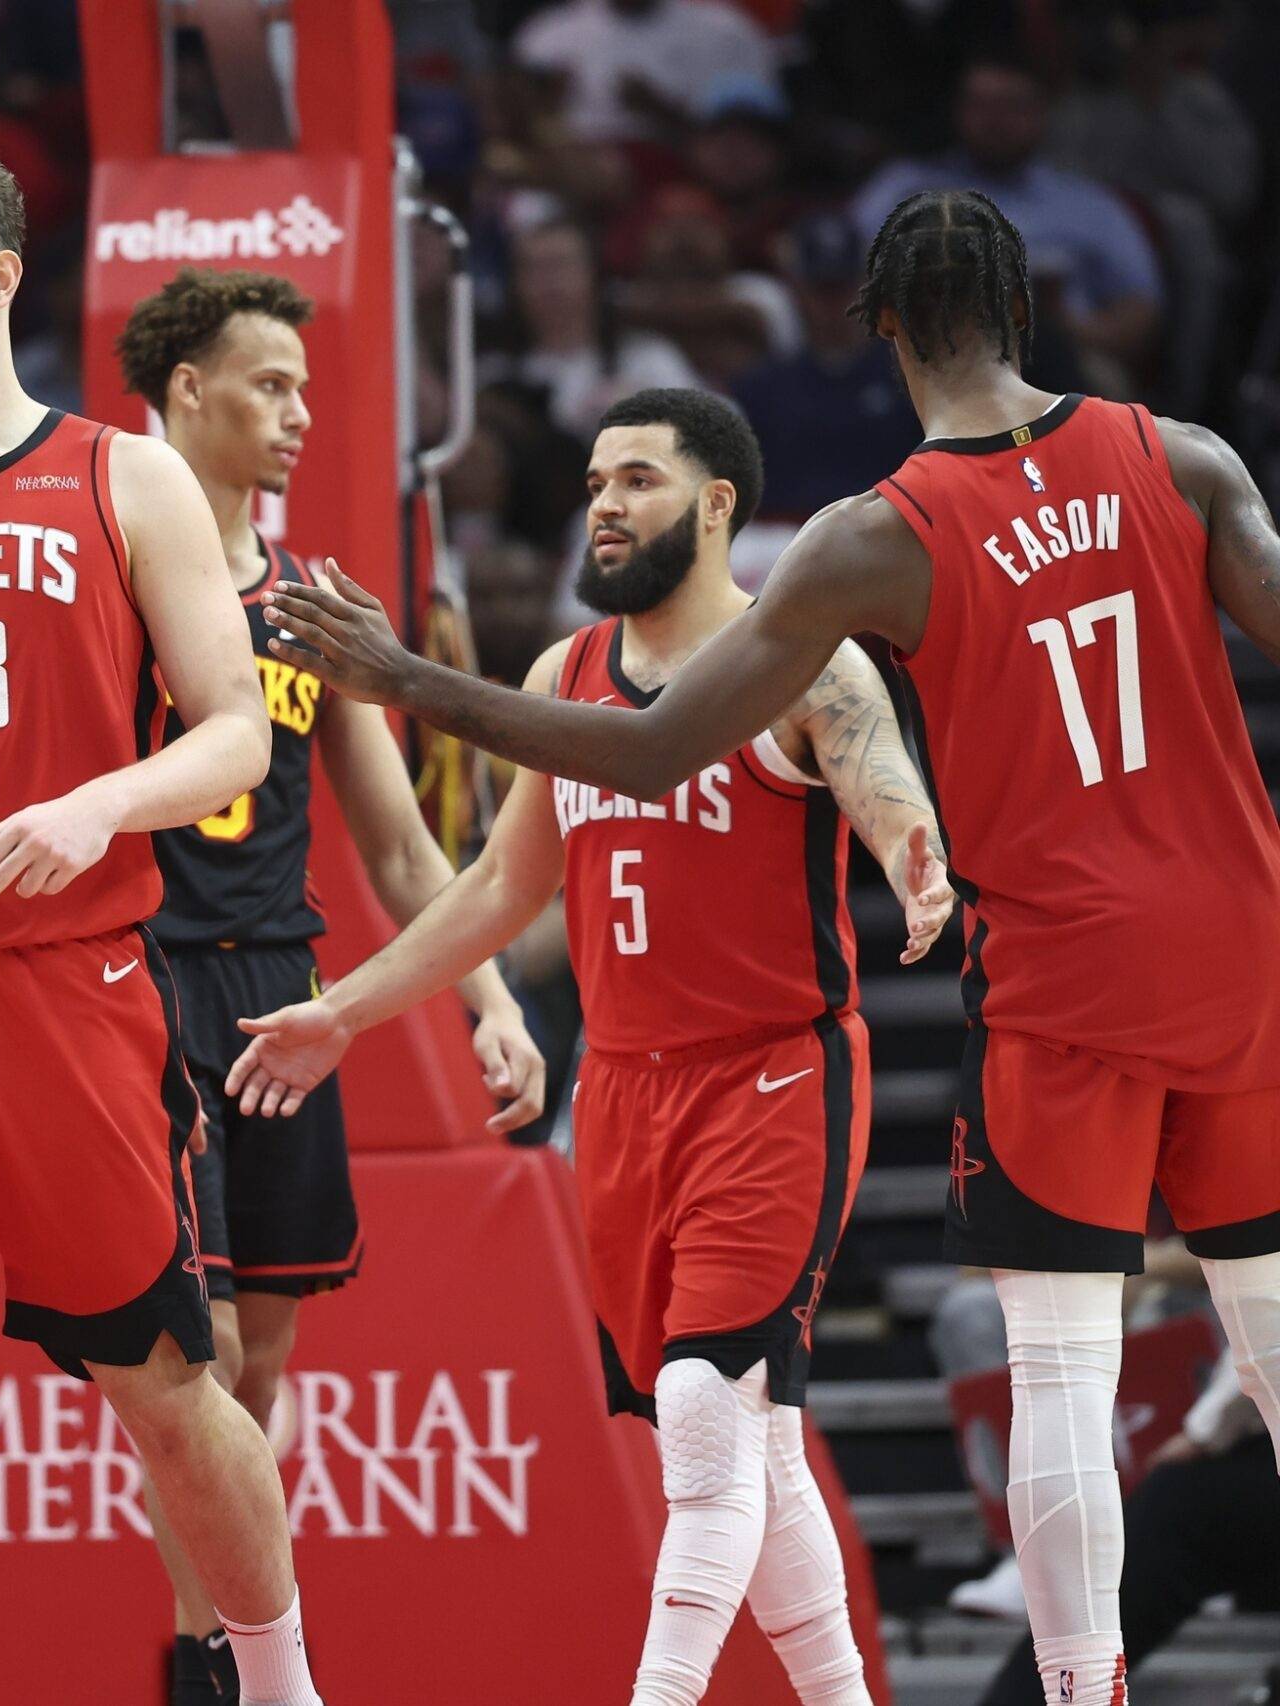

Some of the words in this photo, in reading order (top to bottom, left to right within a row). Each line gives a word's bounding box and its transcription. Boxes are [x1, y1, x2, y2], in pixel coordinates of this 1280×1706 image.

[95, 209, 282, 262] reliant
[982, 494, 1120, 586] EASON
[1027, 590, 1147, 787] 17
[610, 850, 648, 955] 5
